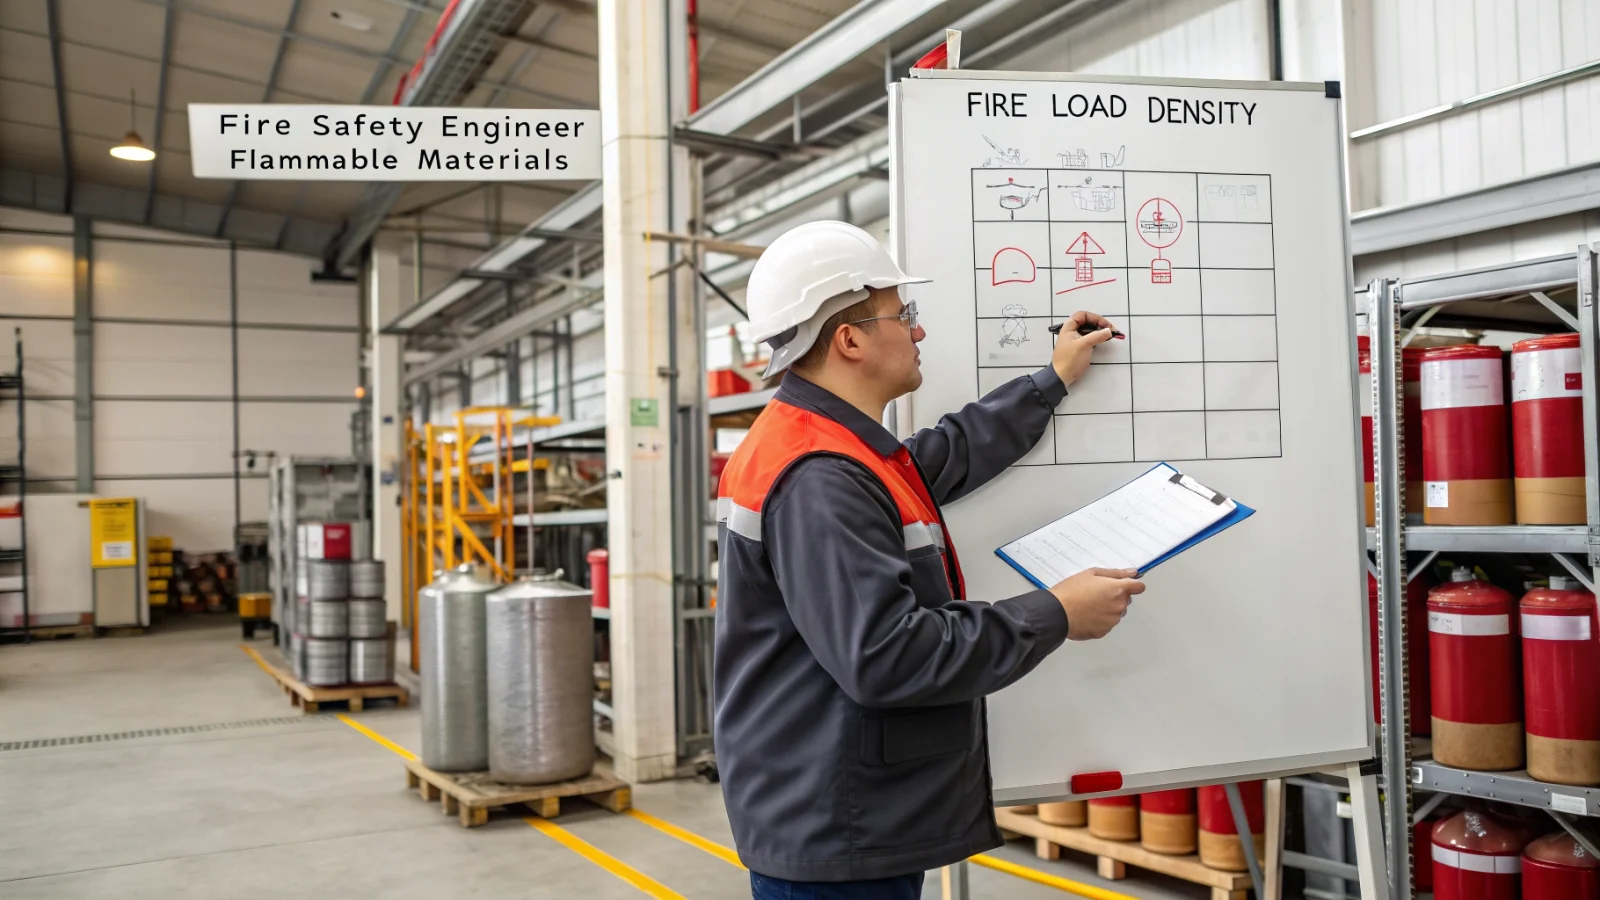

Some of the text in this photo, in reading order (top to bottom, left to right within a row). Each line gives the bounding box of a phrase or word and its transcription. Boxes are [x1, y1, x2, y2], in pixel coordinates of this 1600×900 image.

[966, 91, 1257, 126] FIRE LOAD DENSITY
[219, 113, 586, 145] Fire Safety Engineer
[230, 147, 570, 172] Flammable Materials
